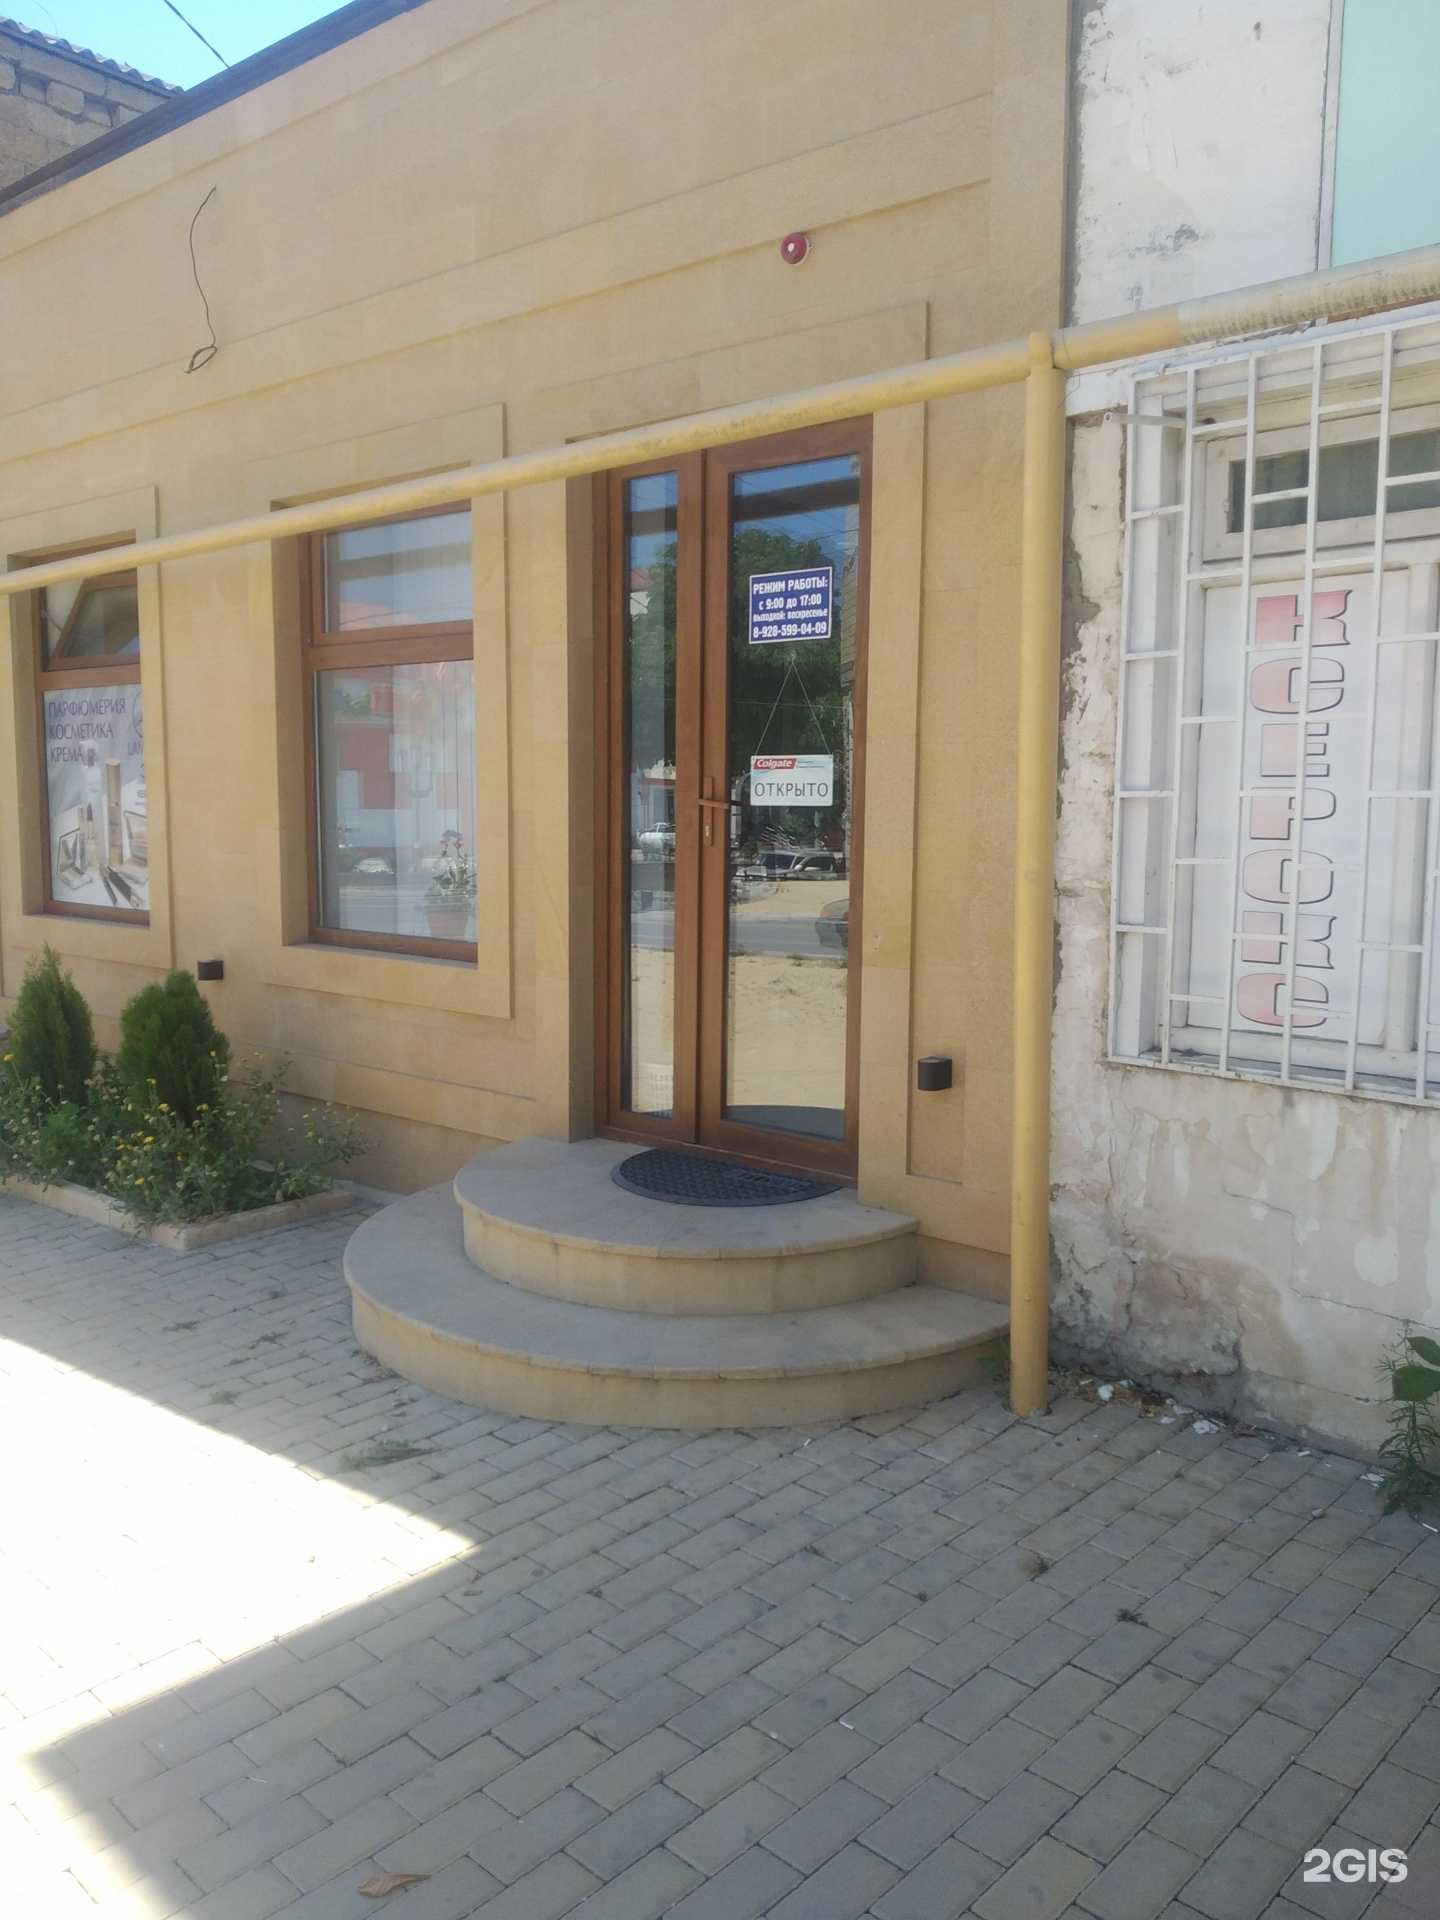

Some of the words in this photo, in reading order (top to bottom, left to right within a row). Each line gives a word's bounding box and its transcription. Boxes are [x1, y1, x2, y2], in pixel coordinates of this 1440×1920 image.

[753, 581, 786, 595] РЕЖИМ
[787, 576, 828, 591] РАБОТЫ:
[765, 597, 784, 610] 9:00
[785, 598, 797, 609] до
[800, 593, 822, 606] 17:00
[752, 622, 827, 639] 8-928-599-04-09
[48, 698, 127, 717] ПАРФЮМЕРИЯ
[48, 722, 114, 740] КОСМЕТИКА
[756, 759, 793, 769] Colgate
[754, 782, 829, 797] ОТКРЫТО
